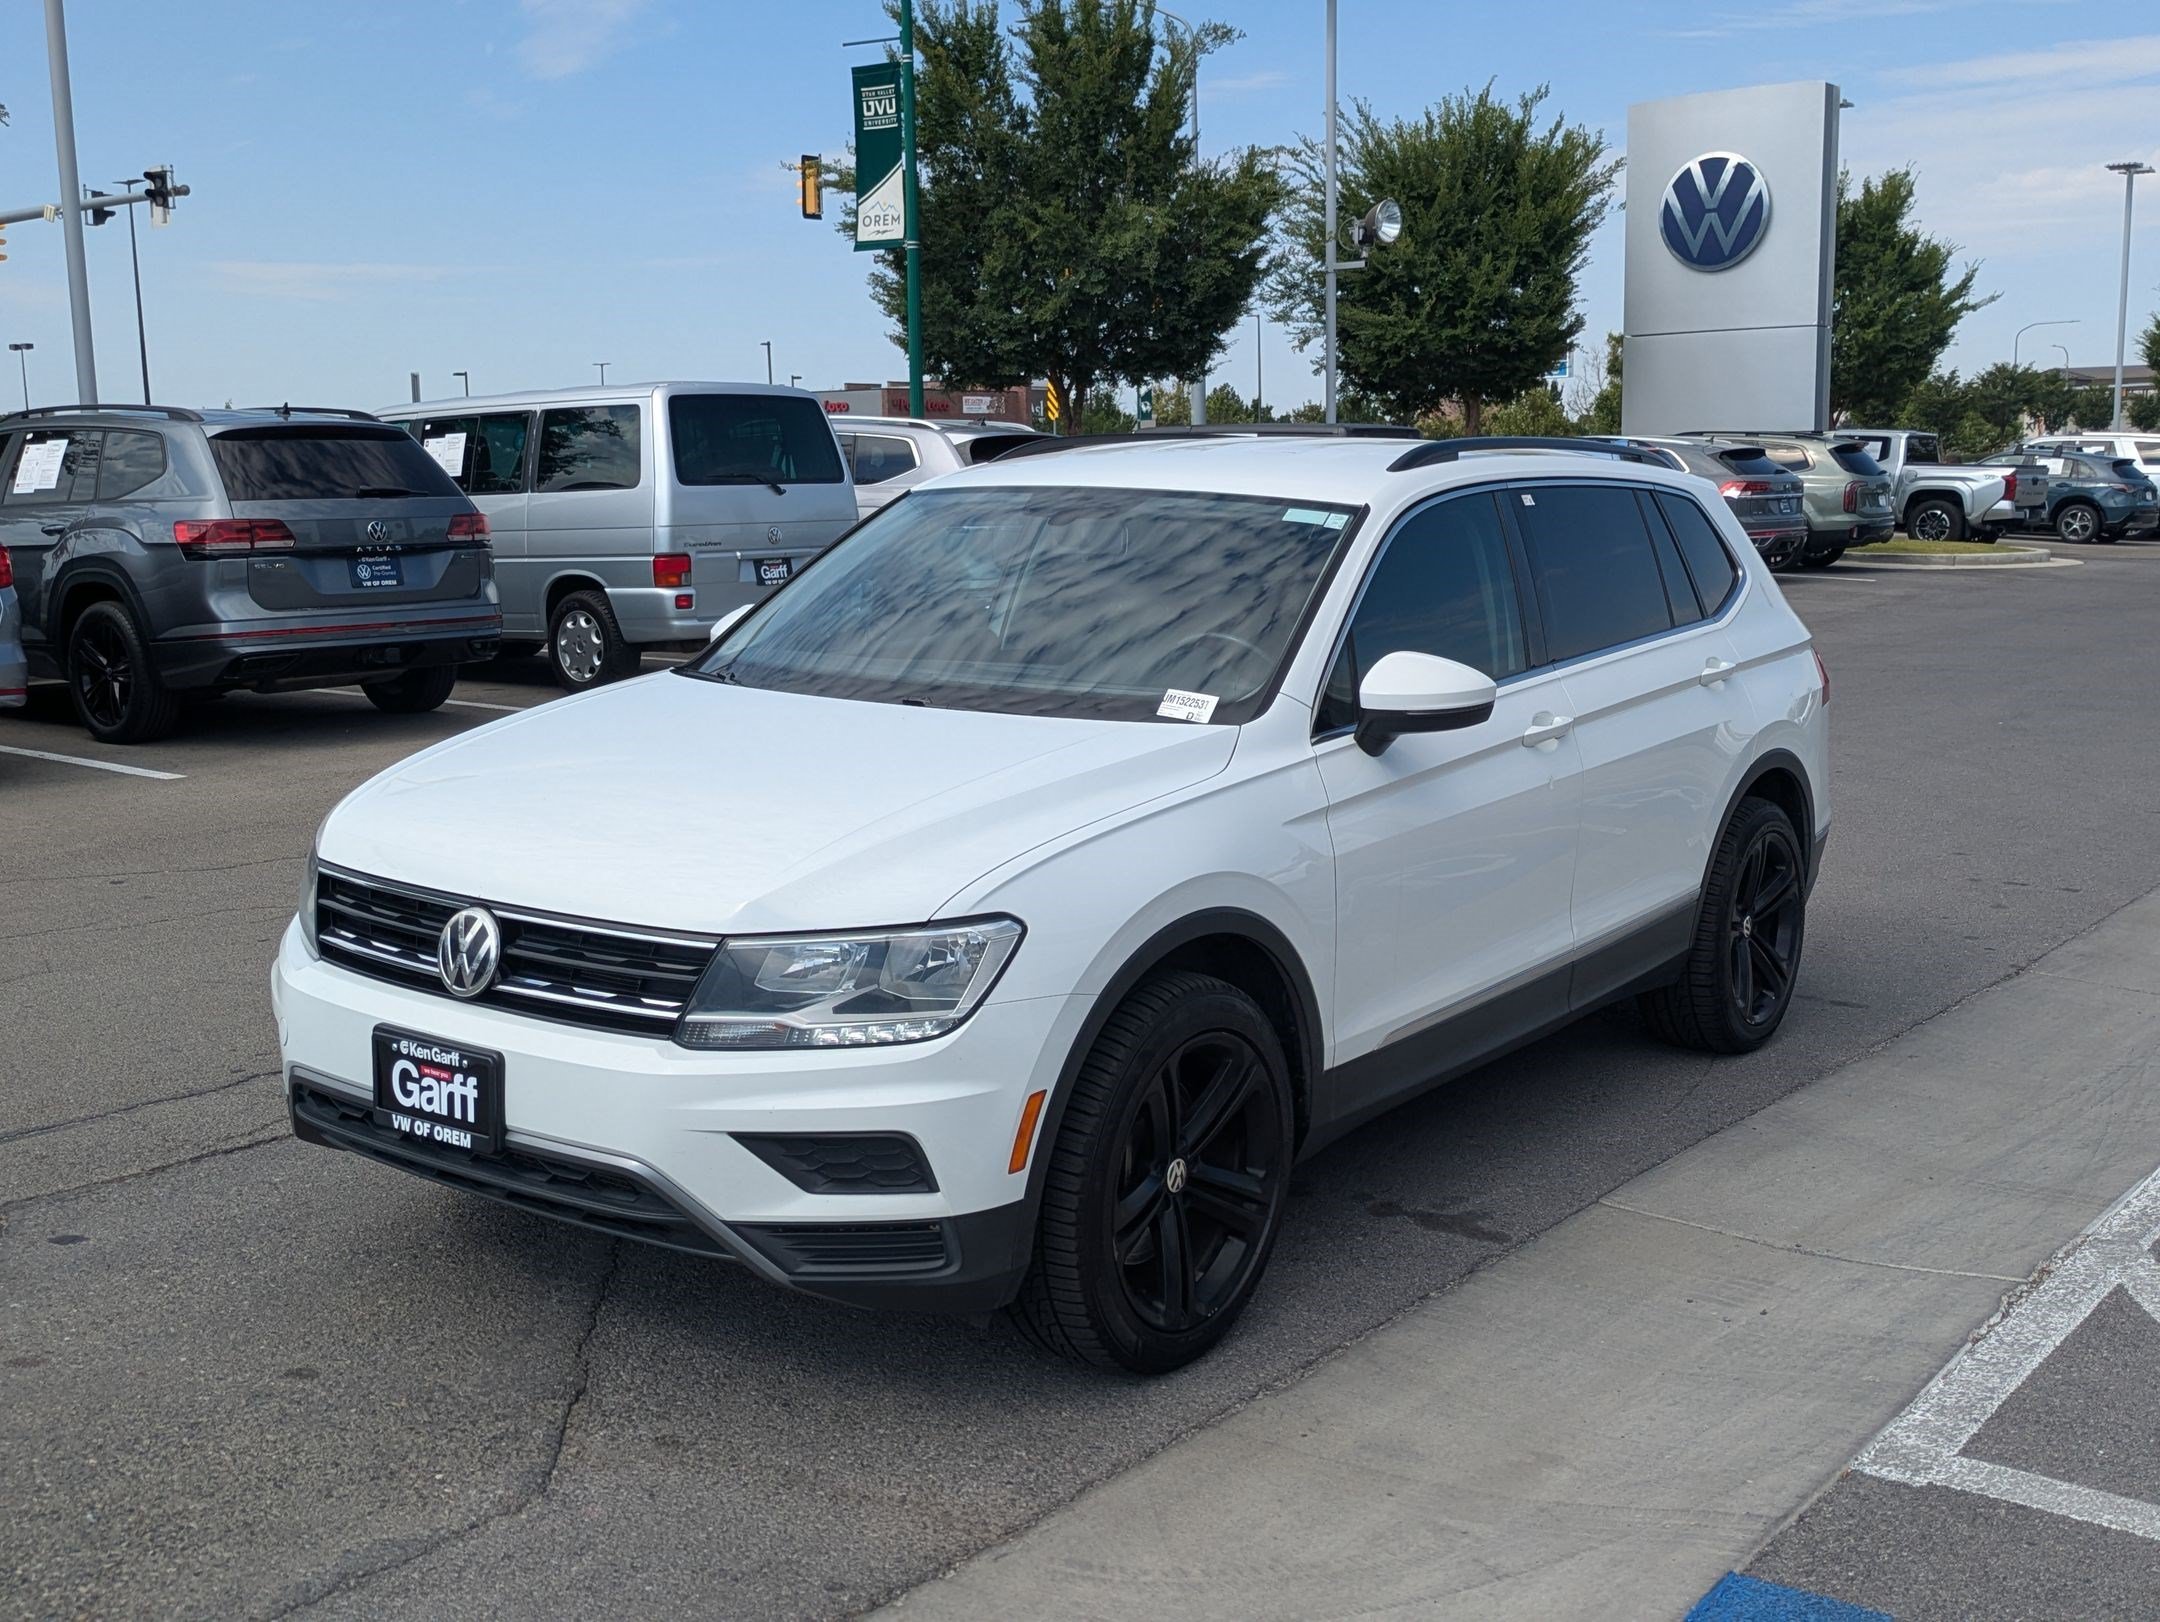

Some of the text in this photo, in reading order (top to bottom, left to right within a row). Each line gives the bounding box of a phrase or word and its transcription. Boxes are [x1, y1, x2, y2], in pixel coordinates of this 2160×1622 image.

[877, 88, 895, 96] VALLEY
[863, 118, 897, 127] UNIVERSITY
[862, 214, 901, 228] OREM
[356, 545, 402, 553] ATLAS
[760, 564, 788, 580] Garff
[391, 1059, 479, 1124] Garff
[392, 1114, 471, 1148] VW OF OREM
